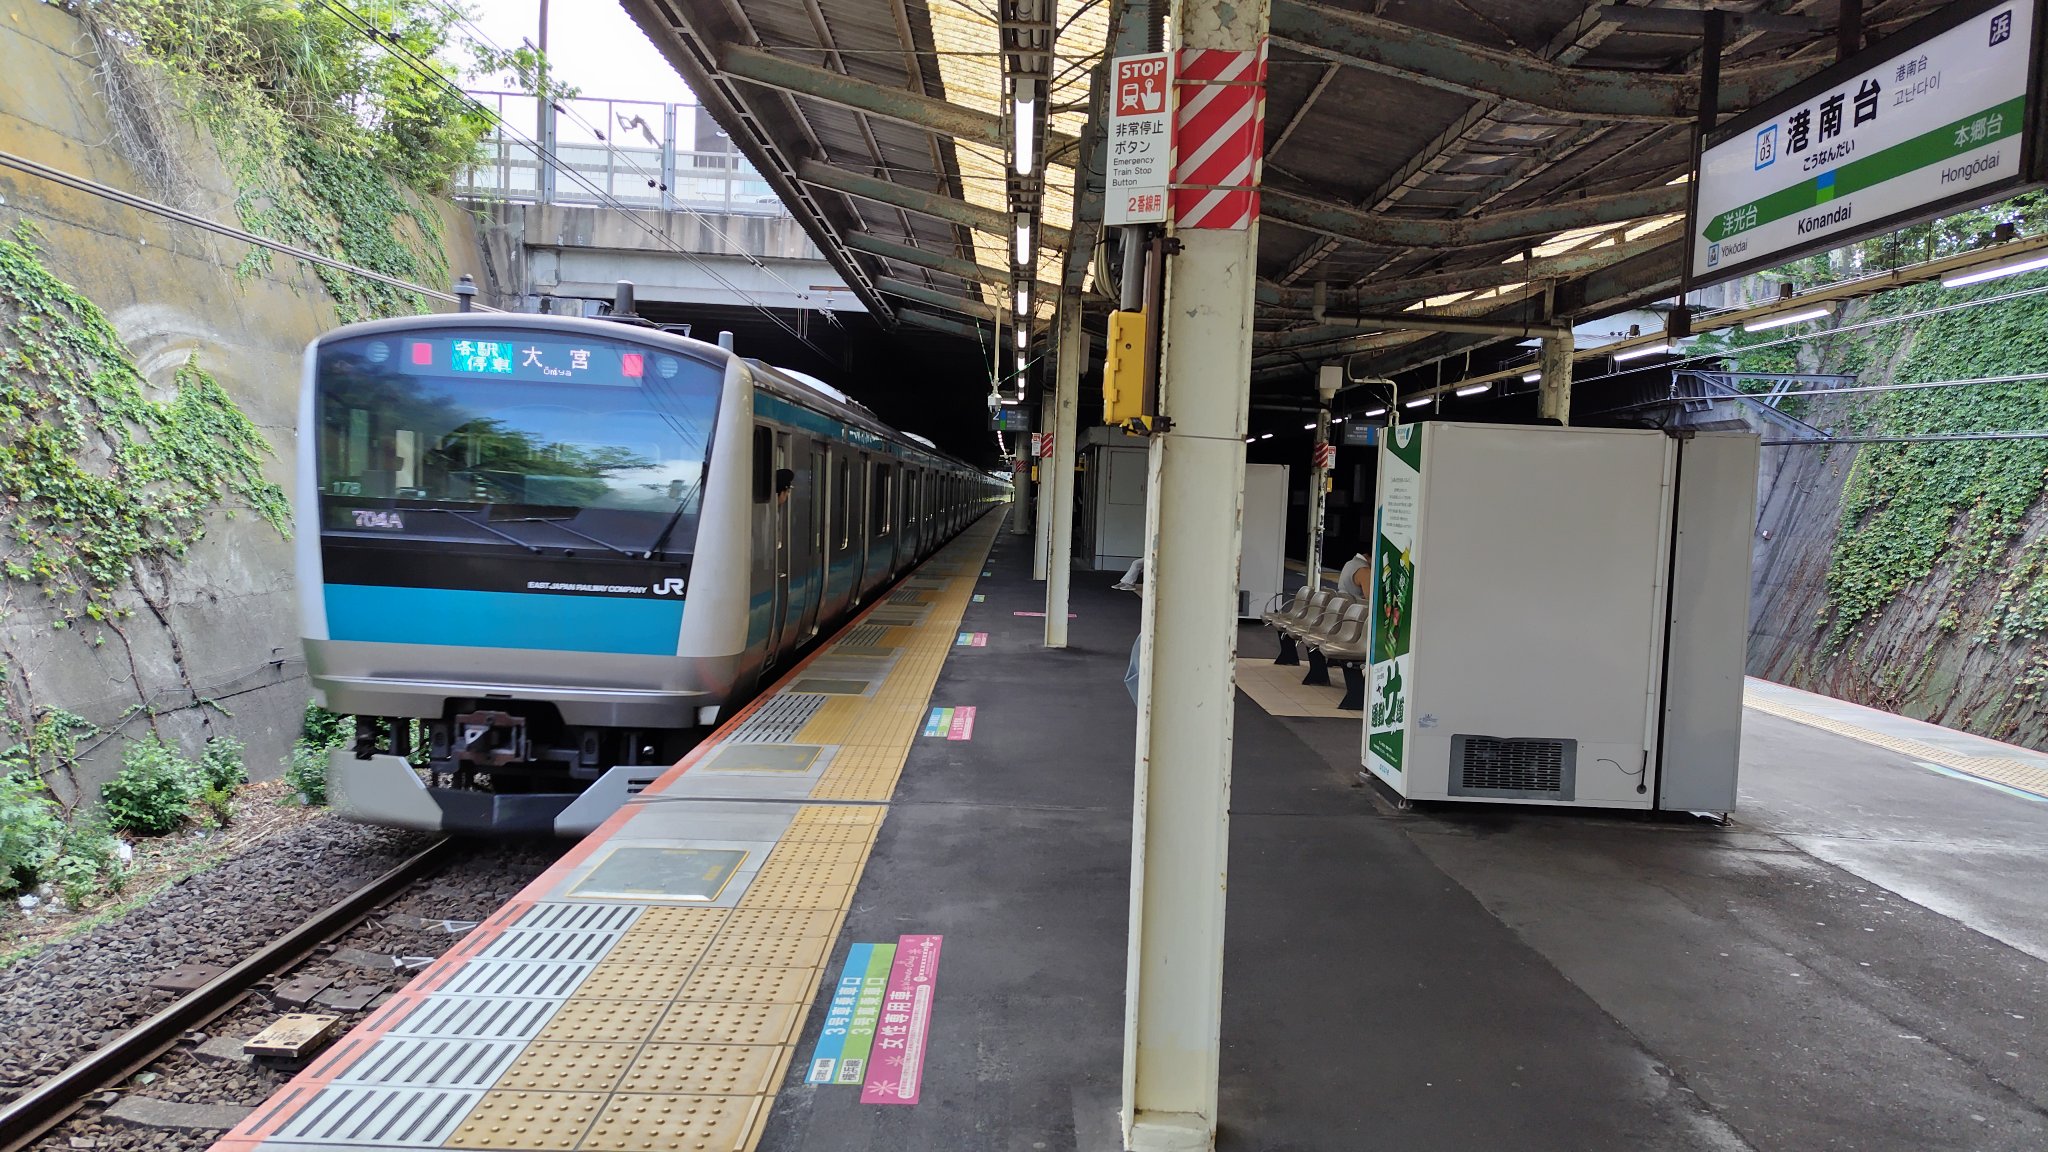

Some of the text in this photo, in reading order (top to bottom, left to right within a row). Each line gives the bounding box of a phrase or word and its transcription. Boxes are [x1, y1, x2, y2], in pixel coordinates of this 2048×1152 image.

[1990, 14, 2009, 44] 浜
[1121, 60, 1165, 80] STOP
[1894, 54, 1929, 83] 港南台
[1892, 71, 1941, 107] 고난다이
[1785, 78, 1881, 156] 港南台
[1115, 120, 1164, 137] 非常停止
[1762, 133, 1771, 146] JK
[1953, 112, 2003, 148] 本郷台
[1114, 140, 1151, 155] ボタン
[1759, 144, 1771, 161] 03
[1803, 139, 1855, 171] こうなんだい
[1113, 156, 1155, 166] Emergency
[1135, 167, 1152, 175] Stop
[1940, 151, 2000, 184] Hongōdai
[1112, 178, 1138, 187] Button
[1128, 194, 1161, 213] 2番線用
[1721, 205, 1758, 236] 洋光台
[1797, 202, 1852, 236] Kōnandai
[1721, 241, 1748, 258] Yōkōdai
[467, 355, 512, 373] 停車
[522, 346, 591, 370] 大宮
[527, 581, 648, 594] EAST JAPAN RAILWAY COMPANY
[653, 578, 685, 595] JR
[825, 977, 862, 1035] 3号車乗車口
[851, 977, 885, 1035] 3号車乗車口
[879, 990, 913, 1050] 女性専用車
